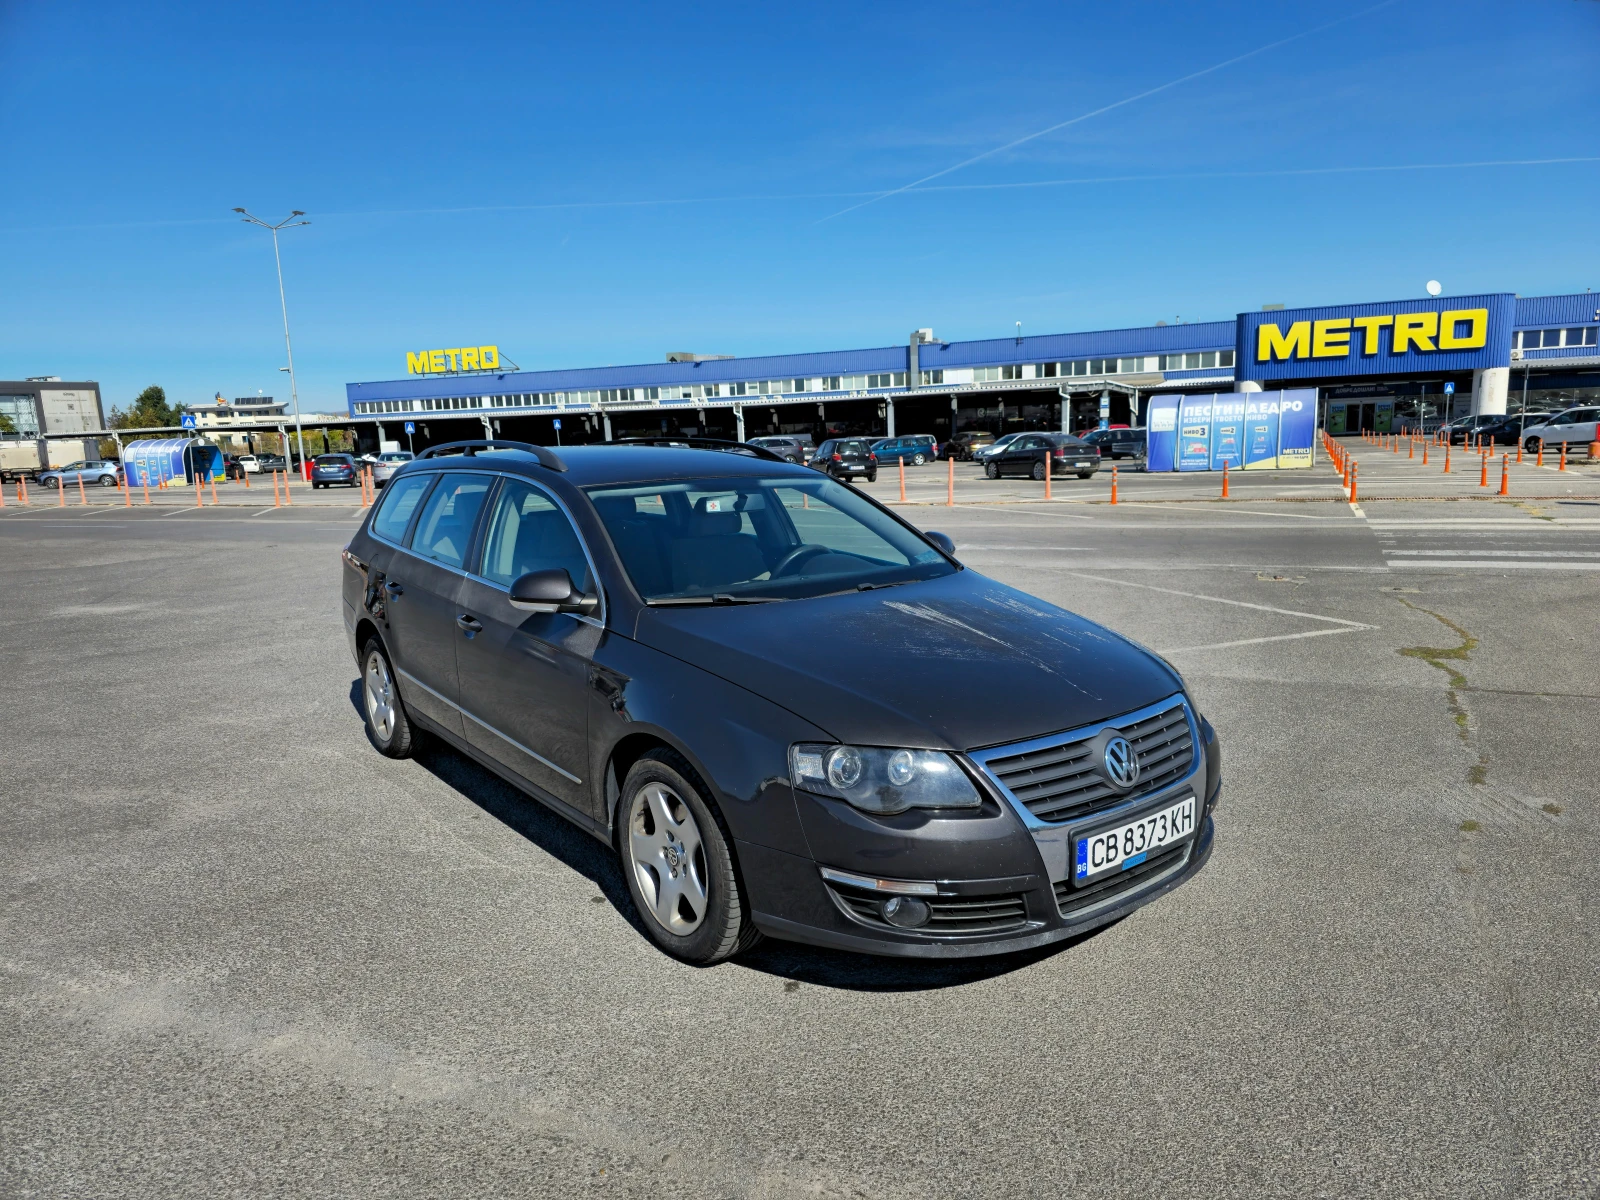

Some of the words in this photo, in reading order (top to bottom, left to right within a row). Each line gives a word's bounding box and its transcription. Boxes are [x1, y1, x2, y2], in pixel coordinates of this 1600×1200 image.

[1257, 308, 1489, 362] METRO
[406, 345, 500, 375] METRO
[1184, 404, 1233, 417] ПЕСТИ
[1234, 403, 1258, 415] НА
[1259, 400, 1303, 415] ЕДРО
[1215, 415, 1242, 423] ТВОЕТО
[1246, 413, 1268, 421] НИВО
[1200, 427, 1206, 436] 3
[1282, 447, 1310, 455] METRO
[1091, 833, 1119, 868] CB
[1123, 814, 1168, 856] 8373
[1171, 802, 1193, 838] KH
[1076, 862, 1087, 874] BG
